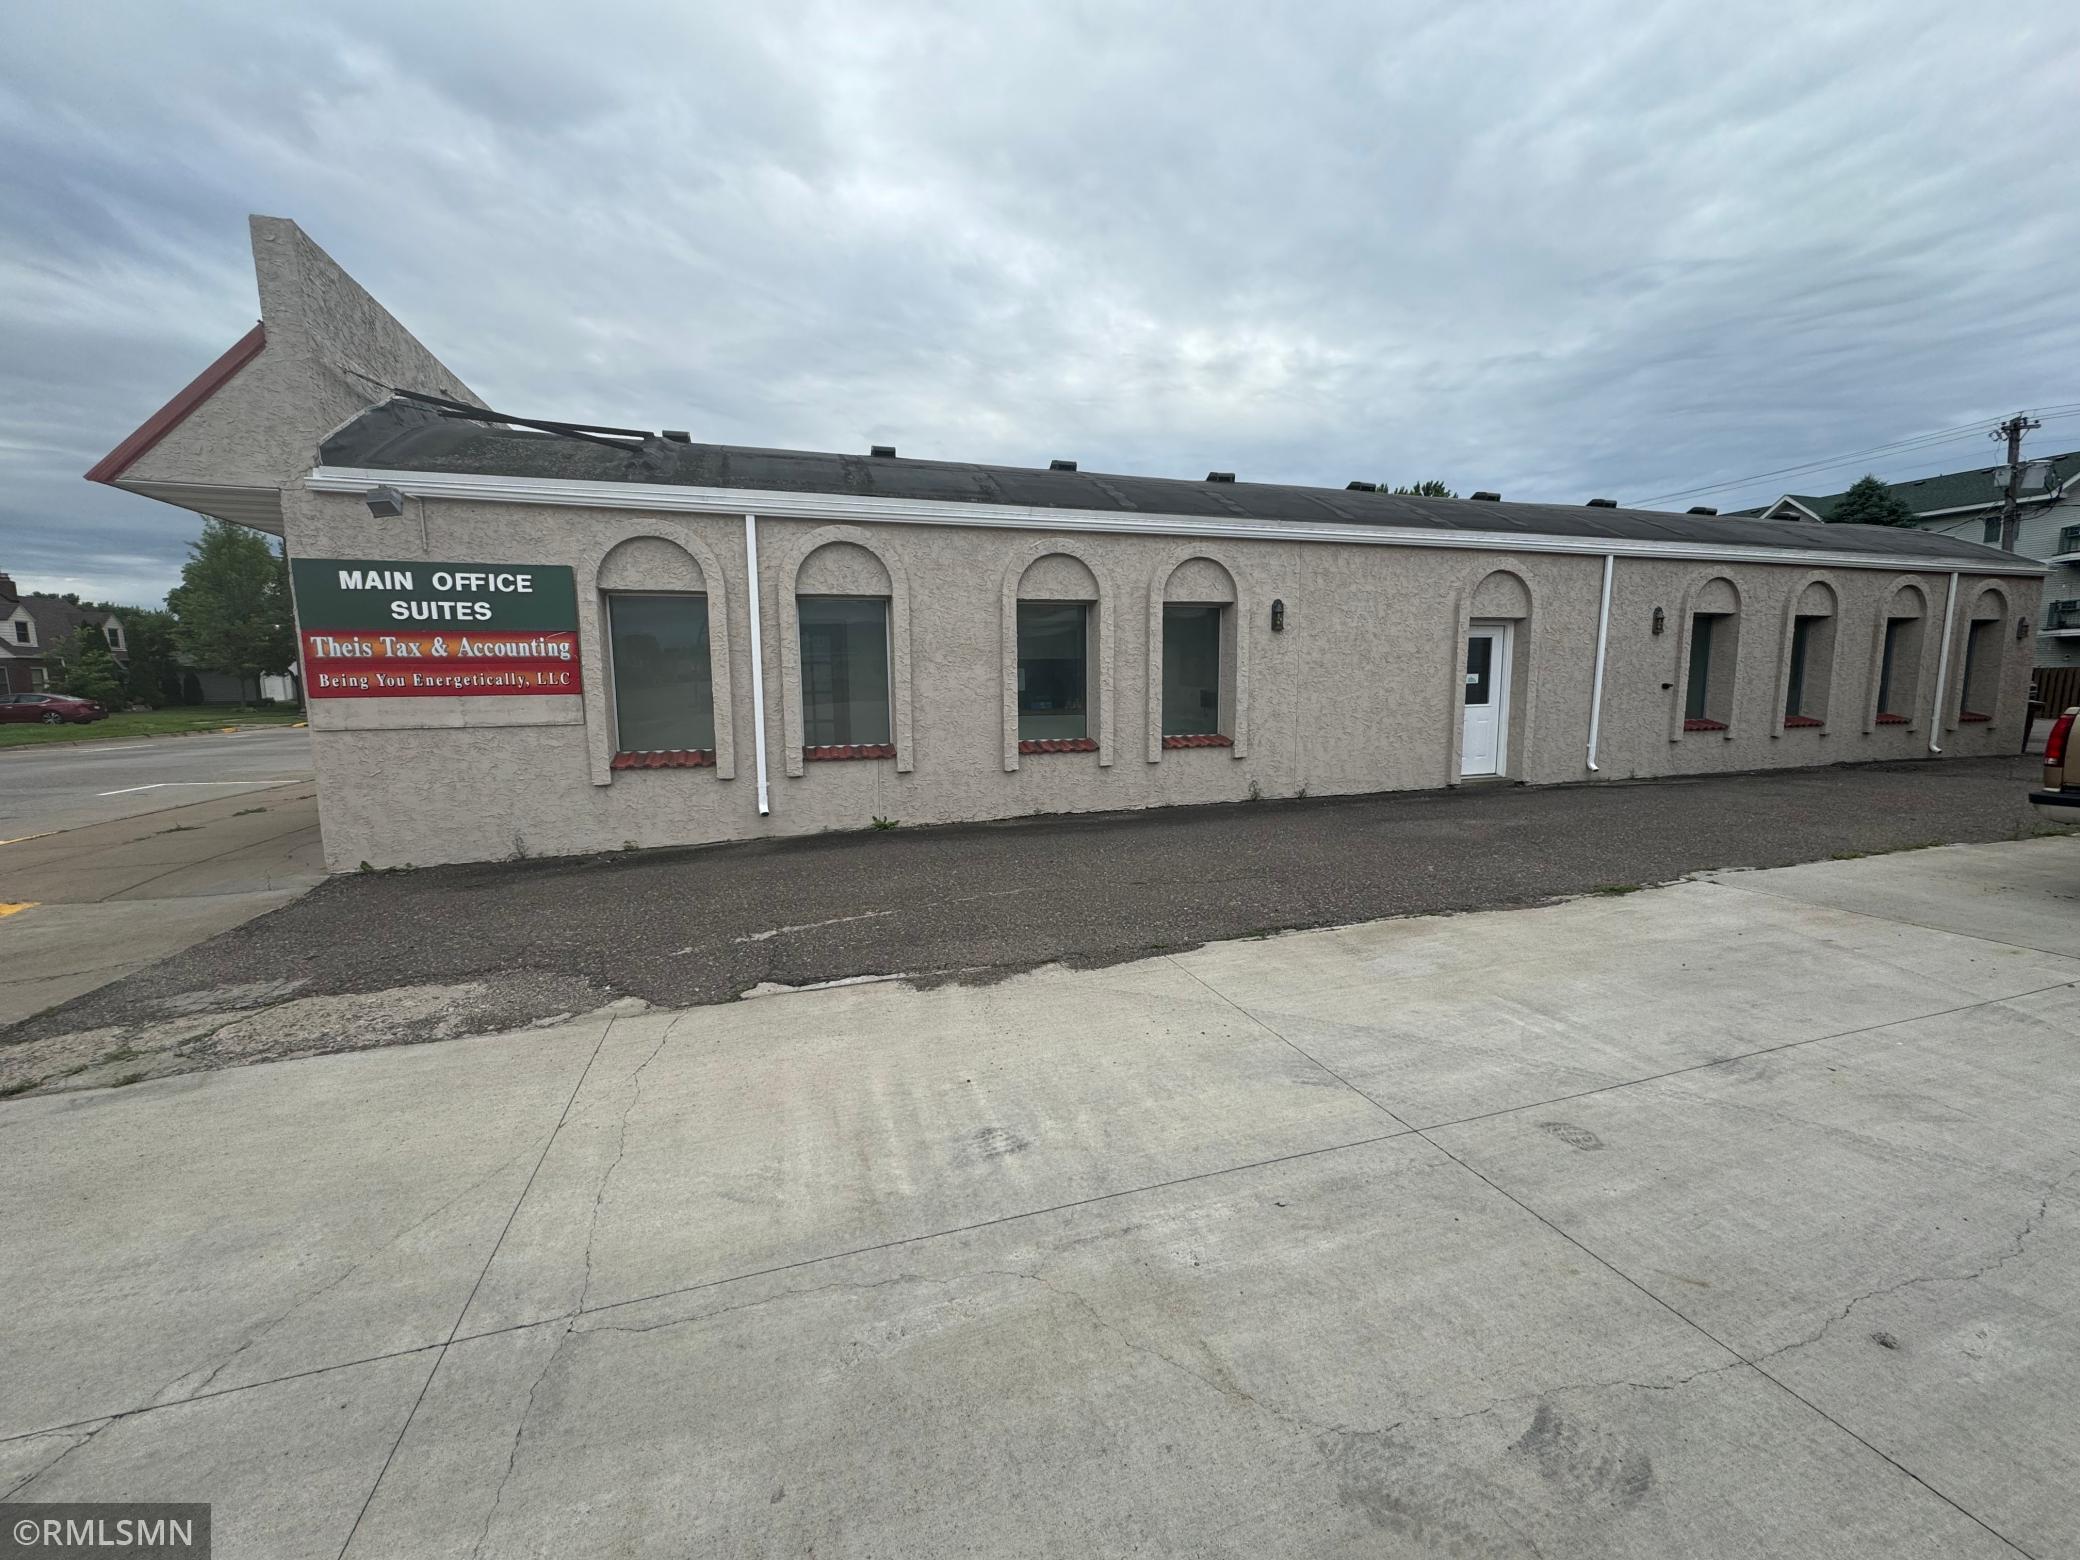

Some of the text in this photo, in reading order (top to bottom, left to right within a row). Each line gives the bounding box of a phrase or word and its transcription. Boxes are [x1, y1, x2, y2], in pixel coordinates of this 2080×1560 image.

[338, 570, 533, 592] MAIN OFFICE
[390, 600, 493, 621] SUITES
[310, 636, 571, 660] Theis Tax & Accounting
[319, 672, 571, 689] Being You Energetically, LLC
